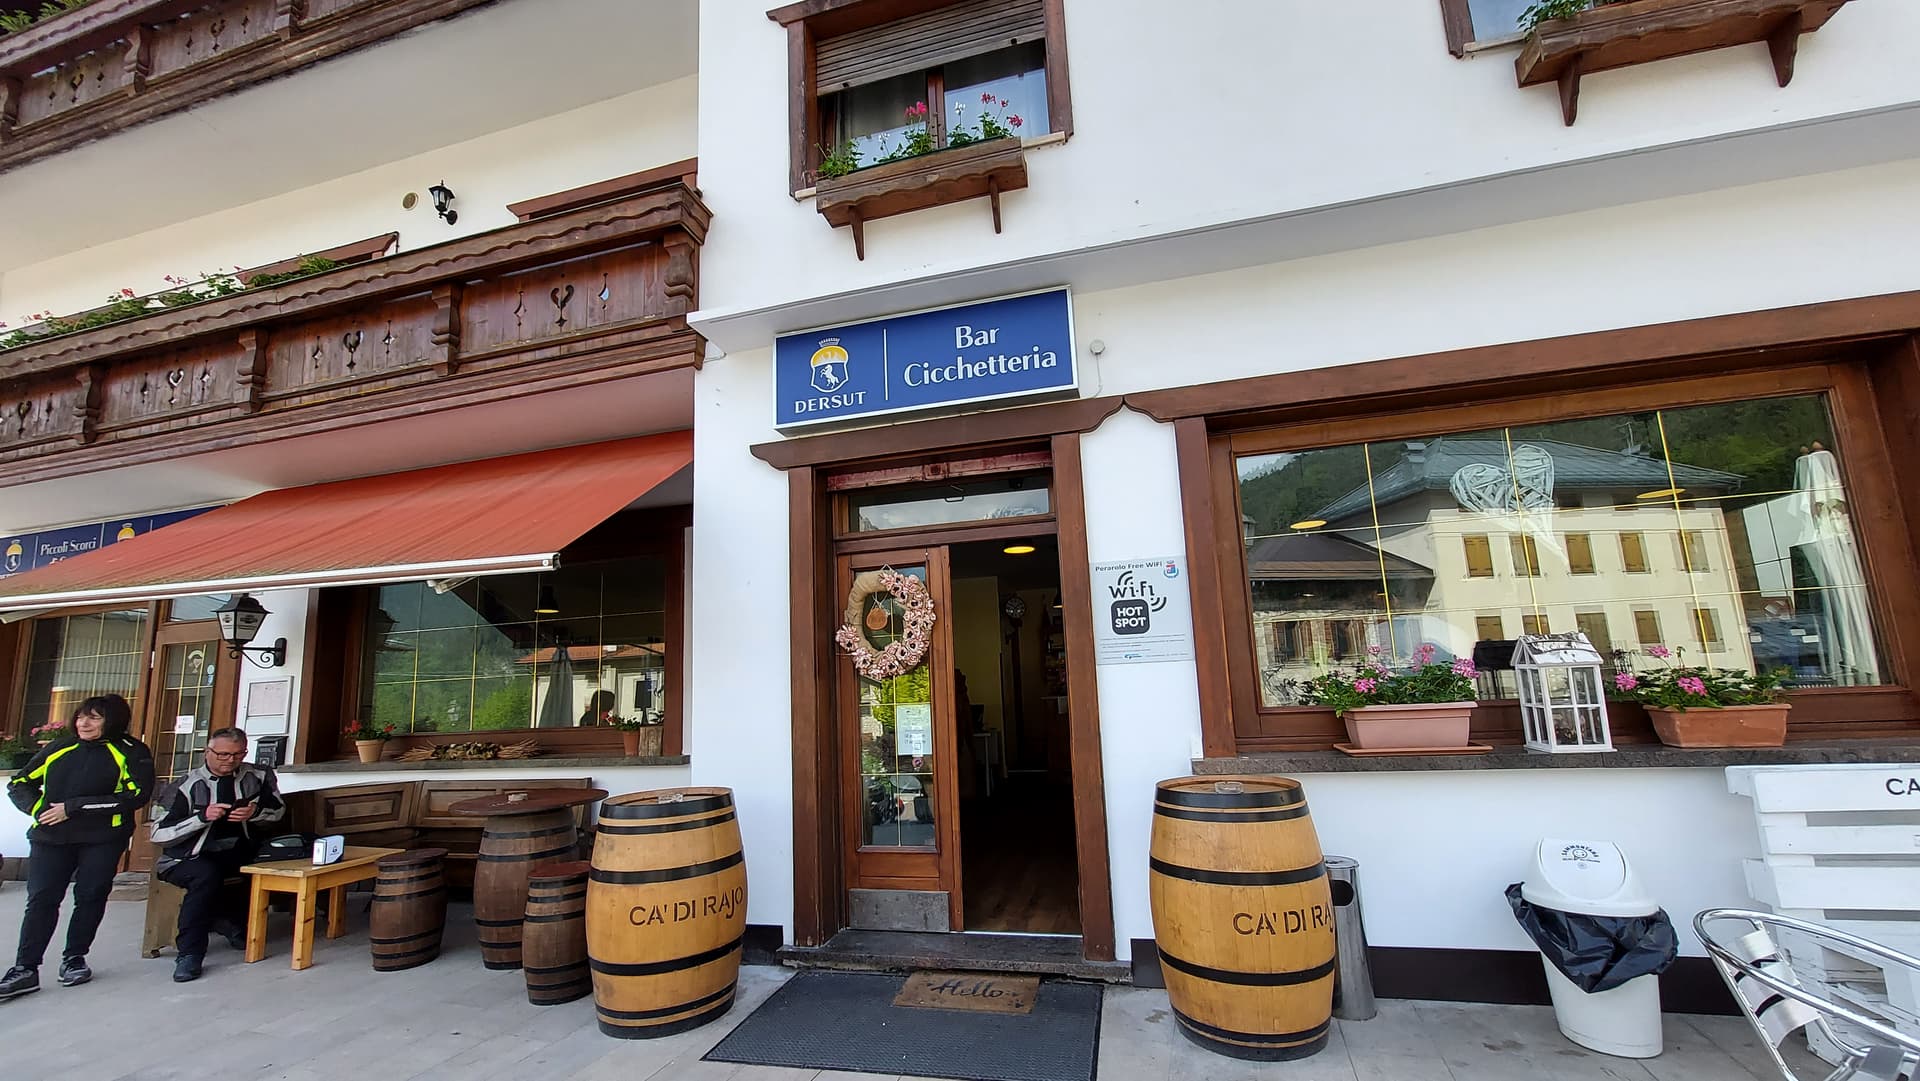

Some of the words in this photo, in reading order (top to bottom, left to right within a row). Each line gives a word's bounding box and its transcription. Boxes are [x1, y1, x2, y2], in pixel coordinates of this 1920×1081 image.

[954, 325, 1000, 349] Bar
[903, 346, 1057, 388] Cicchetteria
[794, 391, 867, 414] DERSUT
[40, 541, 69, 556] Piccoli
[70, 537, 97, 552] Scorci
[1127, 562, 1145, 570] Free
[1115, 616, 1147, 629] SPOT
[1116, 606, 1143, 618] HOT
[673, 900, 697, 923] DI
[703, 886, 744, 920] RAJO
[1282, 908, 1308, 933] DI
[927, 979, 1005, 999] Hello
